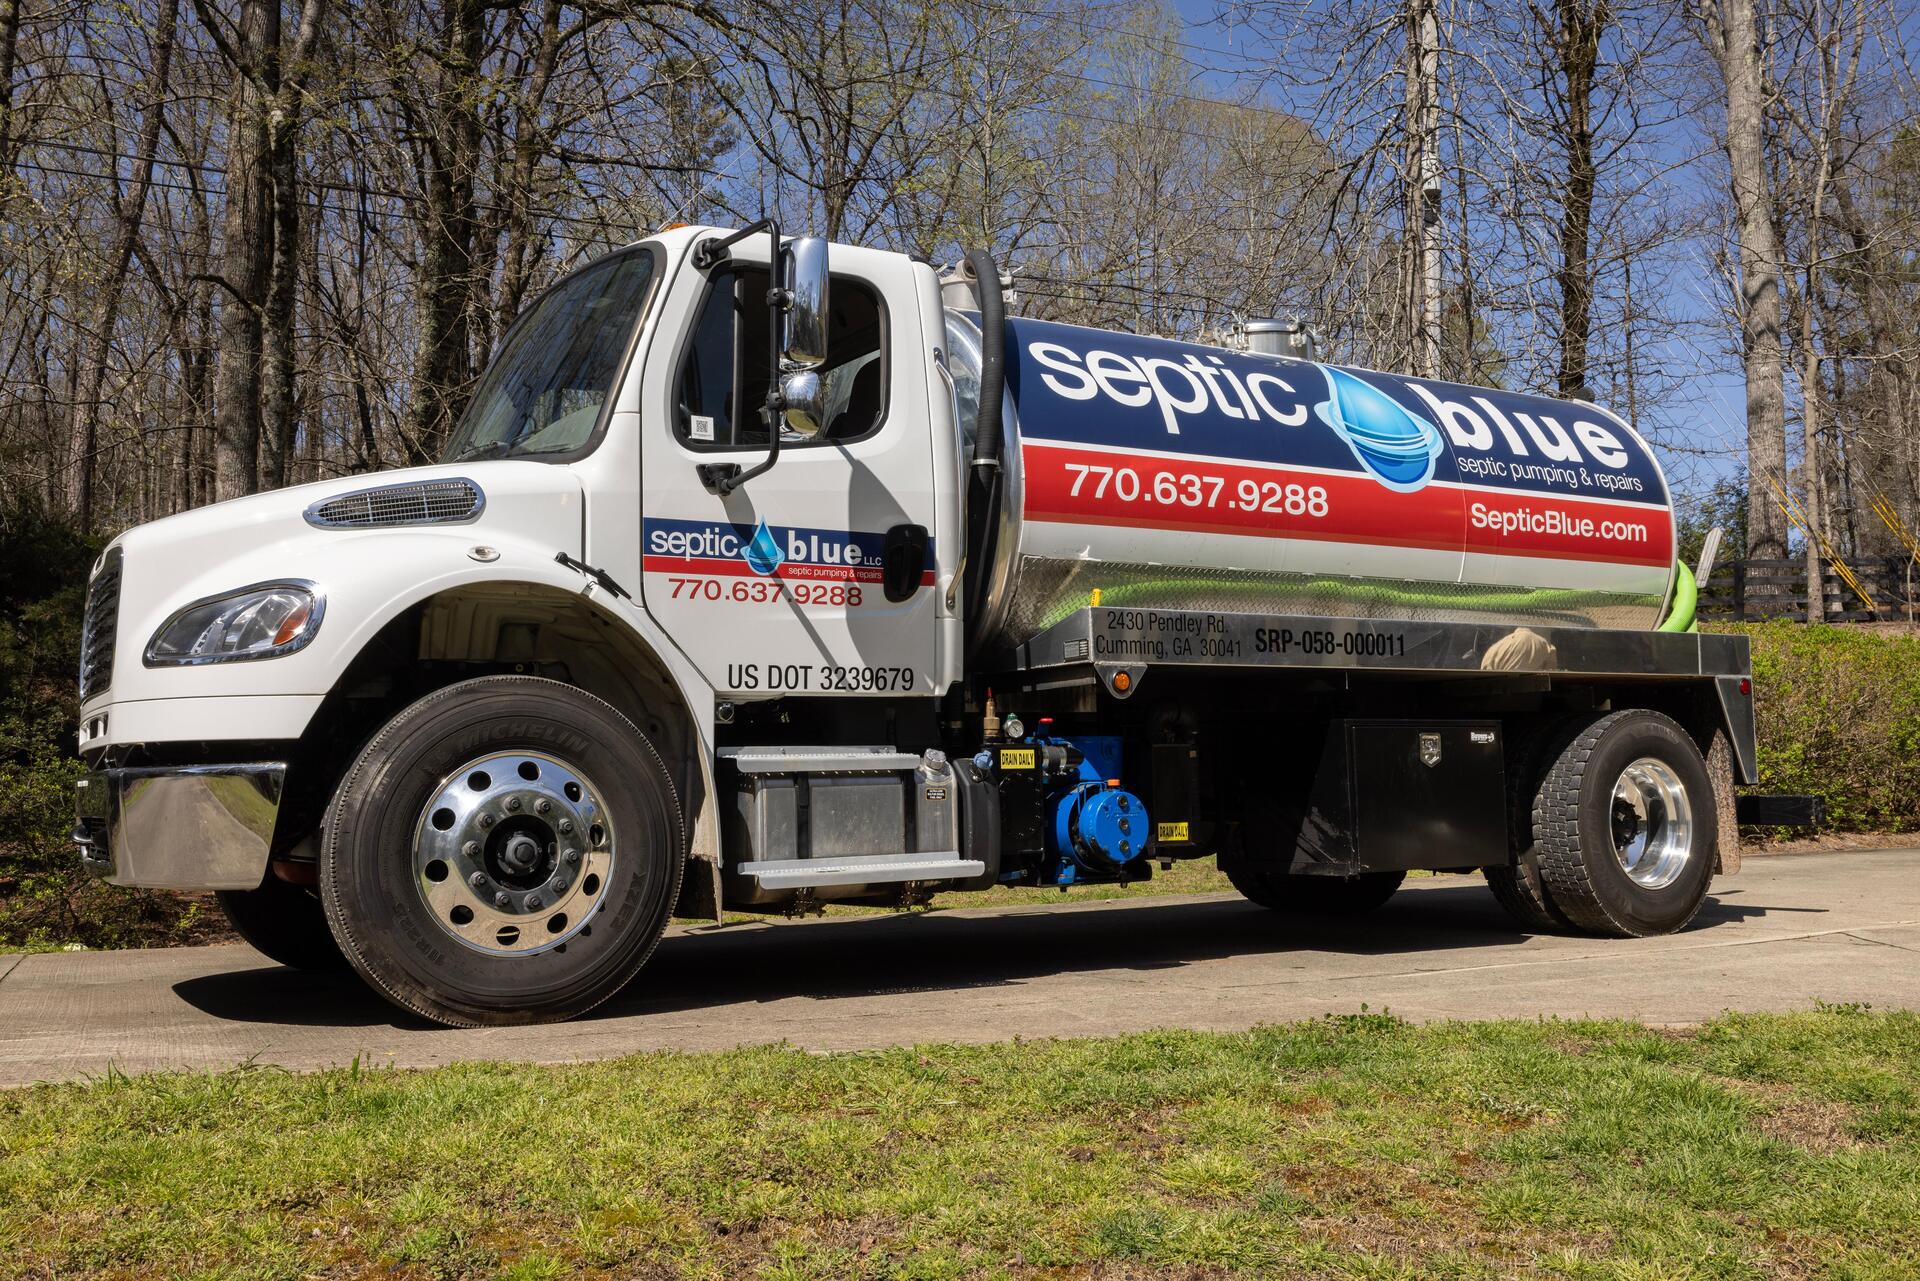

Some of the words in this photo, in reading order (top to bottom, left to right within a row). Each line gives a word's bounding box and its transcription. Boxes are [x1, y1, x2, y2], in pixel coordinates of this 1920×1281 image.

[1028, 342, 1308, 435] septic
[1405, 382, 1629, 470] blue
[1457, 456, 1508, 480] septic
[1509, 461, 1578, 489] pumping
[1579, 467, 1592, 486] &
[1594, 472, 1644, 493] repairs
[1064, 463, 1330, 518] 770.637.9288
[1470, 503, 1648, 543] SepticBlue.com
[650, 528, 738, 561] septic
[788, 530, 862, 565] blue
[863, 556, 882, 566] LLC
[788, 566, 812, 577] septic
[813, 568, 848, 579] pumping
[849, 569, 855, 578] &
[856, 570, 882, 580] repairs
[668, 578, 863, 607] 770.637.9288
[1107, 611, 1144, 630] 2430
[1149, 612, 1201, 632] Pendley
[1206, 615, 1229, 633] Rd.
[1095, 635, 1168, 658] Cumming,
[1173, 637, 1191, 656] GA
[1200, 638, 1241, 657] 30041
[1255, 628, 1404, 656] SRP-058-000011
[728, 664, 759, 689] US
[768, 664, 813, 690] DOT
[819, 666, 914, 690] 3239679
[1001, 752, 1018, 766] DRAIN
[1018, 752, 1034, 766] DAILY
